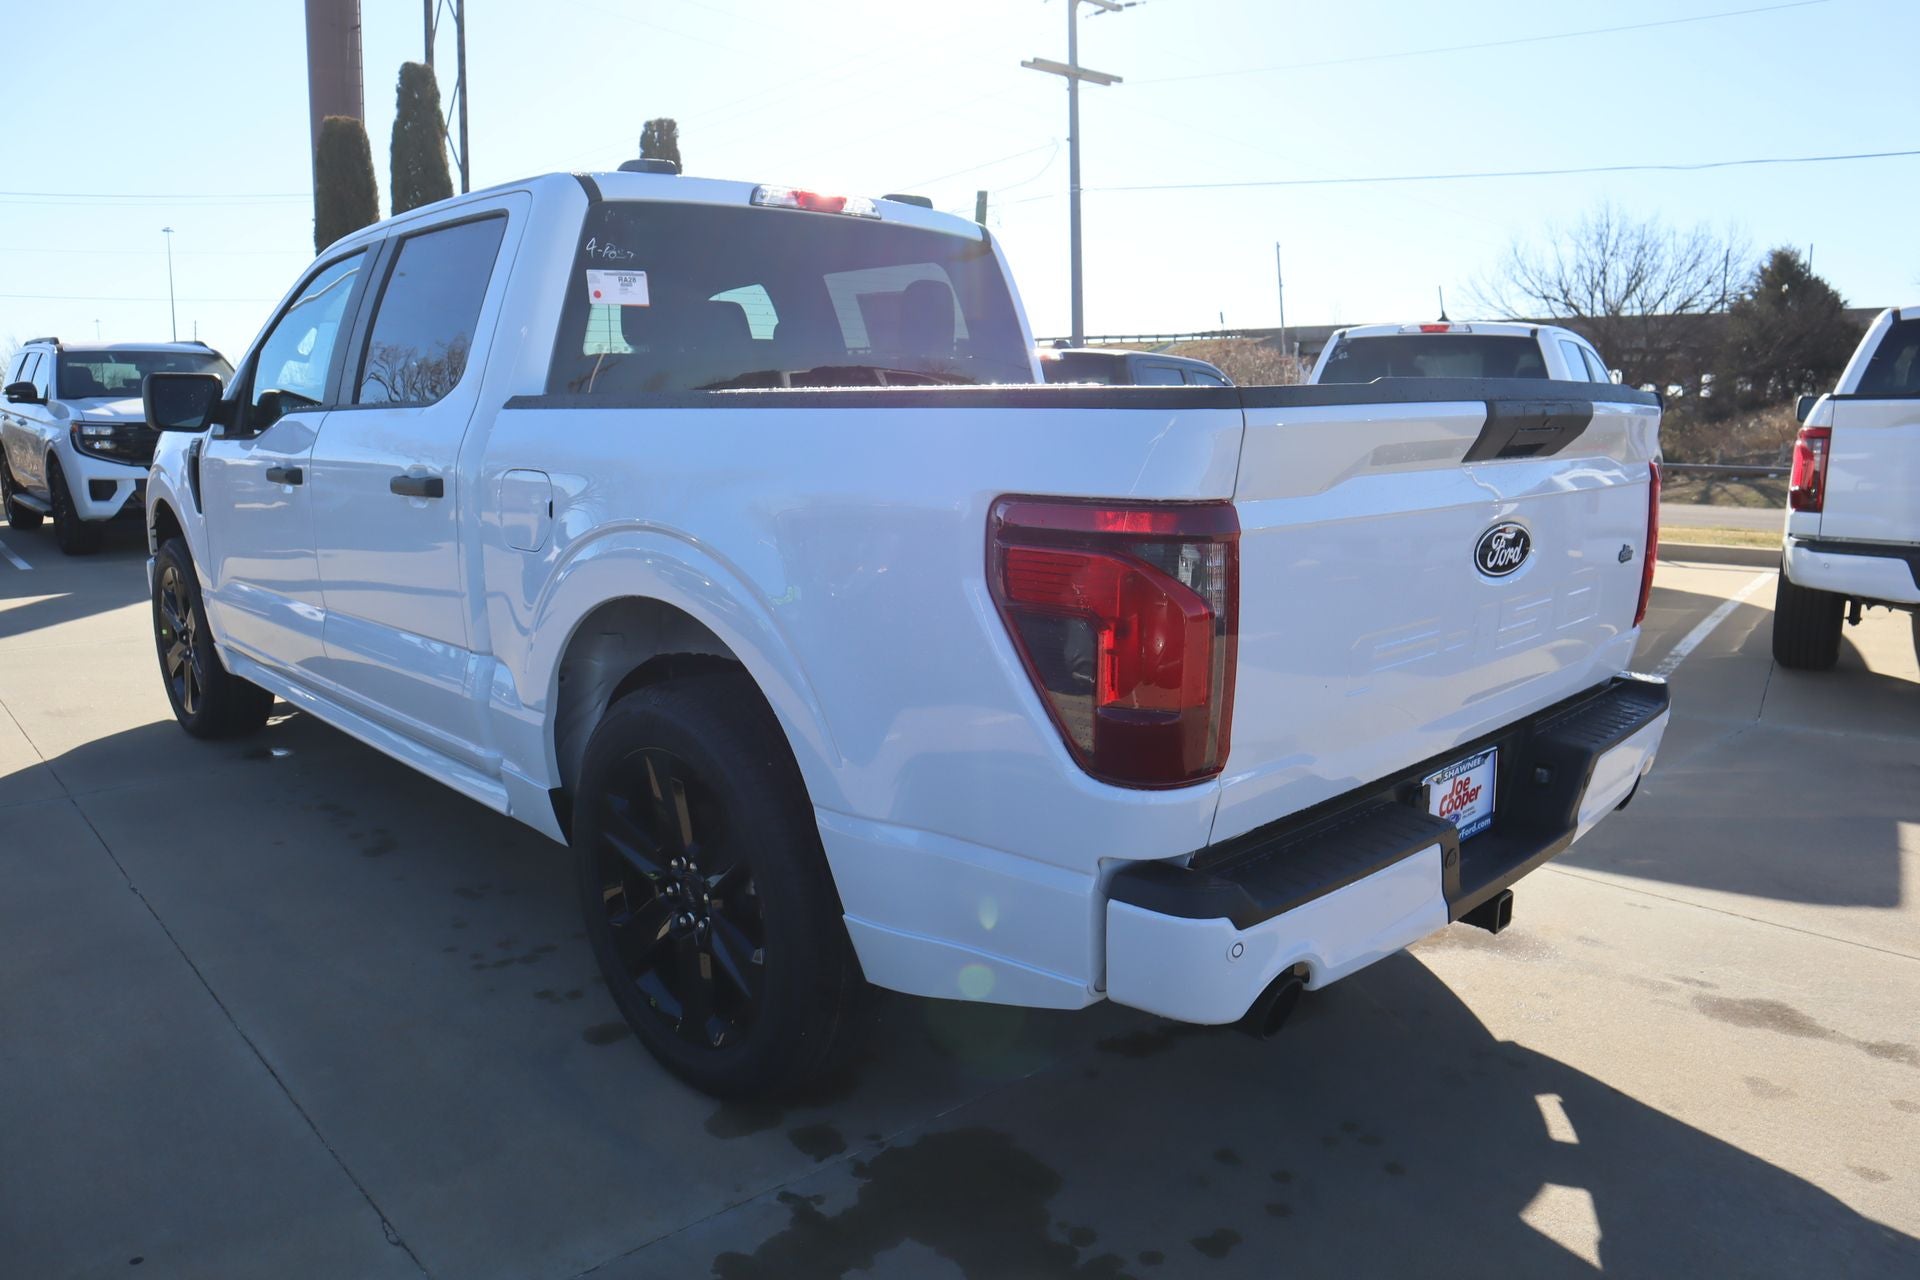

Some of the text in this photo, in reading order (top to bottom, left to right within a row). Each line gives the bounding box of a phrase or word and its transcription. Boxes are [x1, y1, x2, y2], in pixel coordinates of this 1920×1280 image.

[1487, 532, 1524, 568] Ford
[1443, 756, 1482, 780] SHAWNEE
[1438, 784, 1482, 817] Cooper
[1448, 776, 1471, 798] Joe
